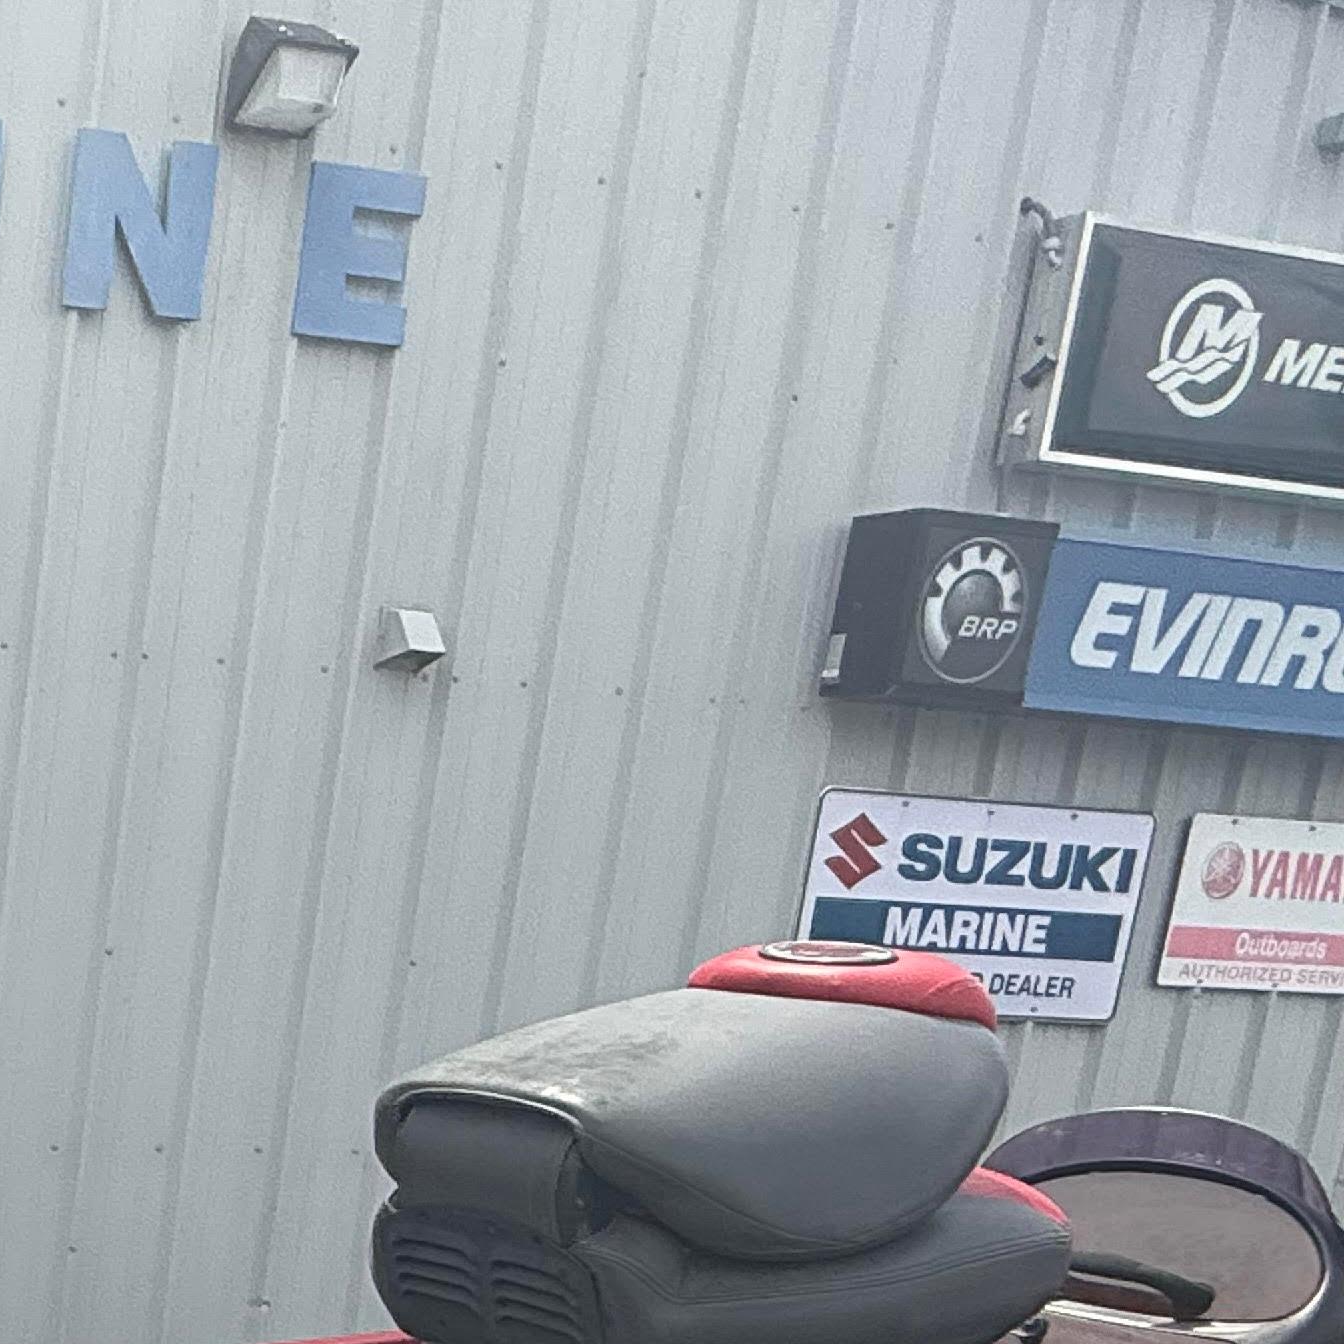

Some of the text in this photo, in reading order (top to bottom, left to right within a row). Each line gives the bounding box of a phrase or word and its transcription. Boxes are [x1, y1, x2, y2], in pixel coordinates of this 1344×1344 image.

[1263, 338, 1344, 394] ME
[957, 616, 1017, 640] BRP
[897, 832, 1138, 893] SUZUKI
[1249, 848, 1344, 903] YAMA
[883, 906, 1052, 954] MARINE
[1235, 932, 1327, 960] Outboards
[989, 972, 1075, 998] DEALER
[1179, 963, 1292, 982] AUTHORIZED
